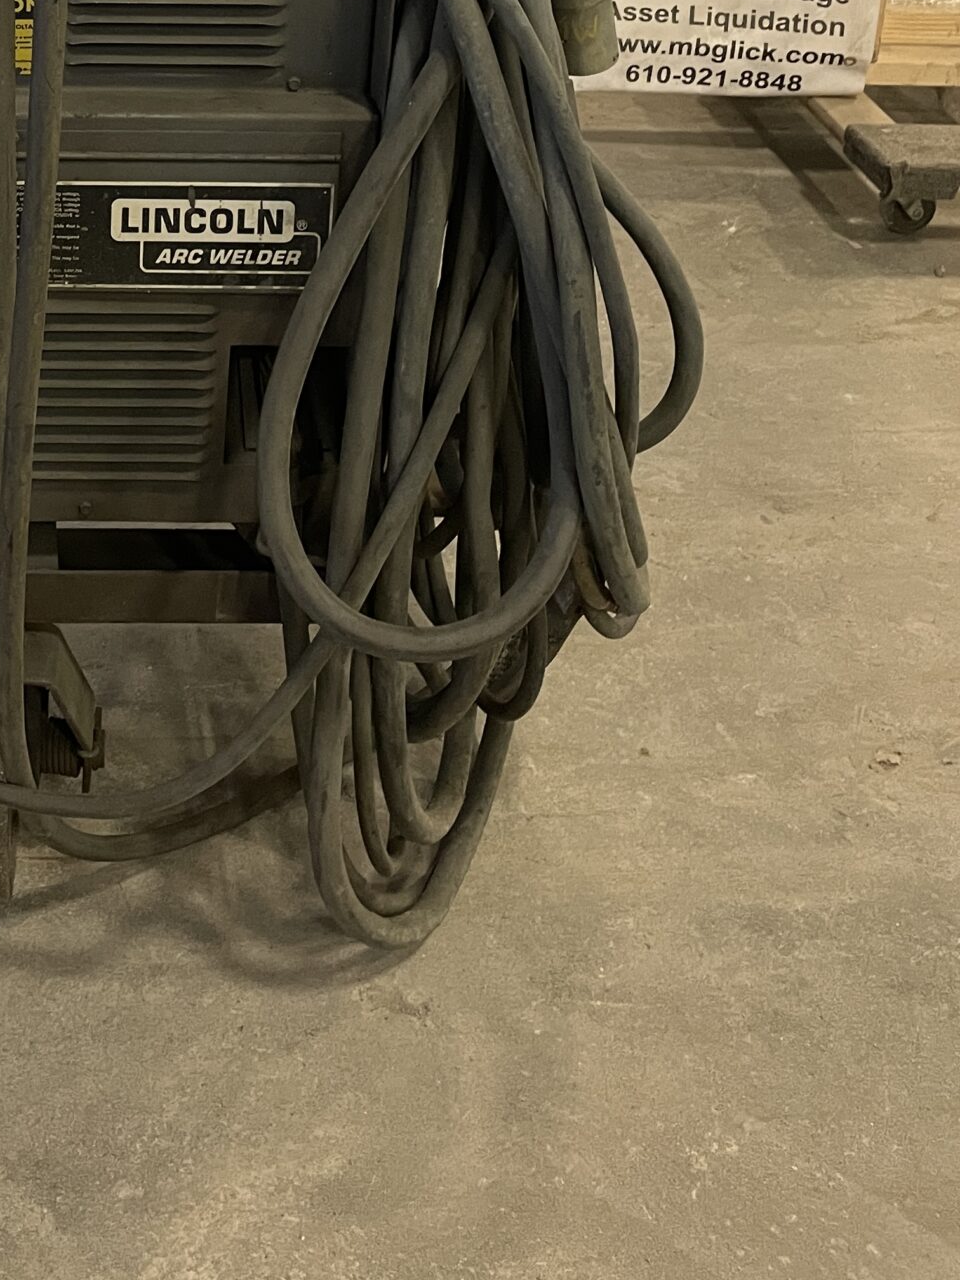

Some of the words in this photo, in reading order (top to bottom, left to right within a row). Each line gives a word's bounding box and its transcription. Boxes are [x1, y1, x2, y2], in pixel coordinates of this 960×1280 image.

[121, 207, 283, 234] LINCOLN
[155, 249, 203, 264] ARC
[210, 249, 301, 265] WELDER
